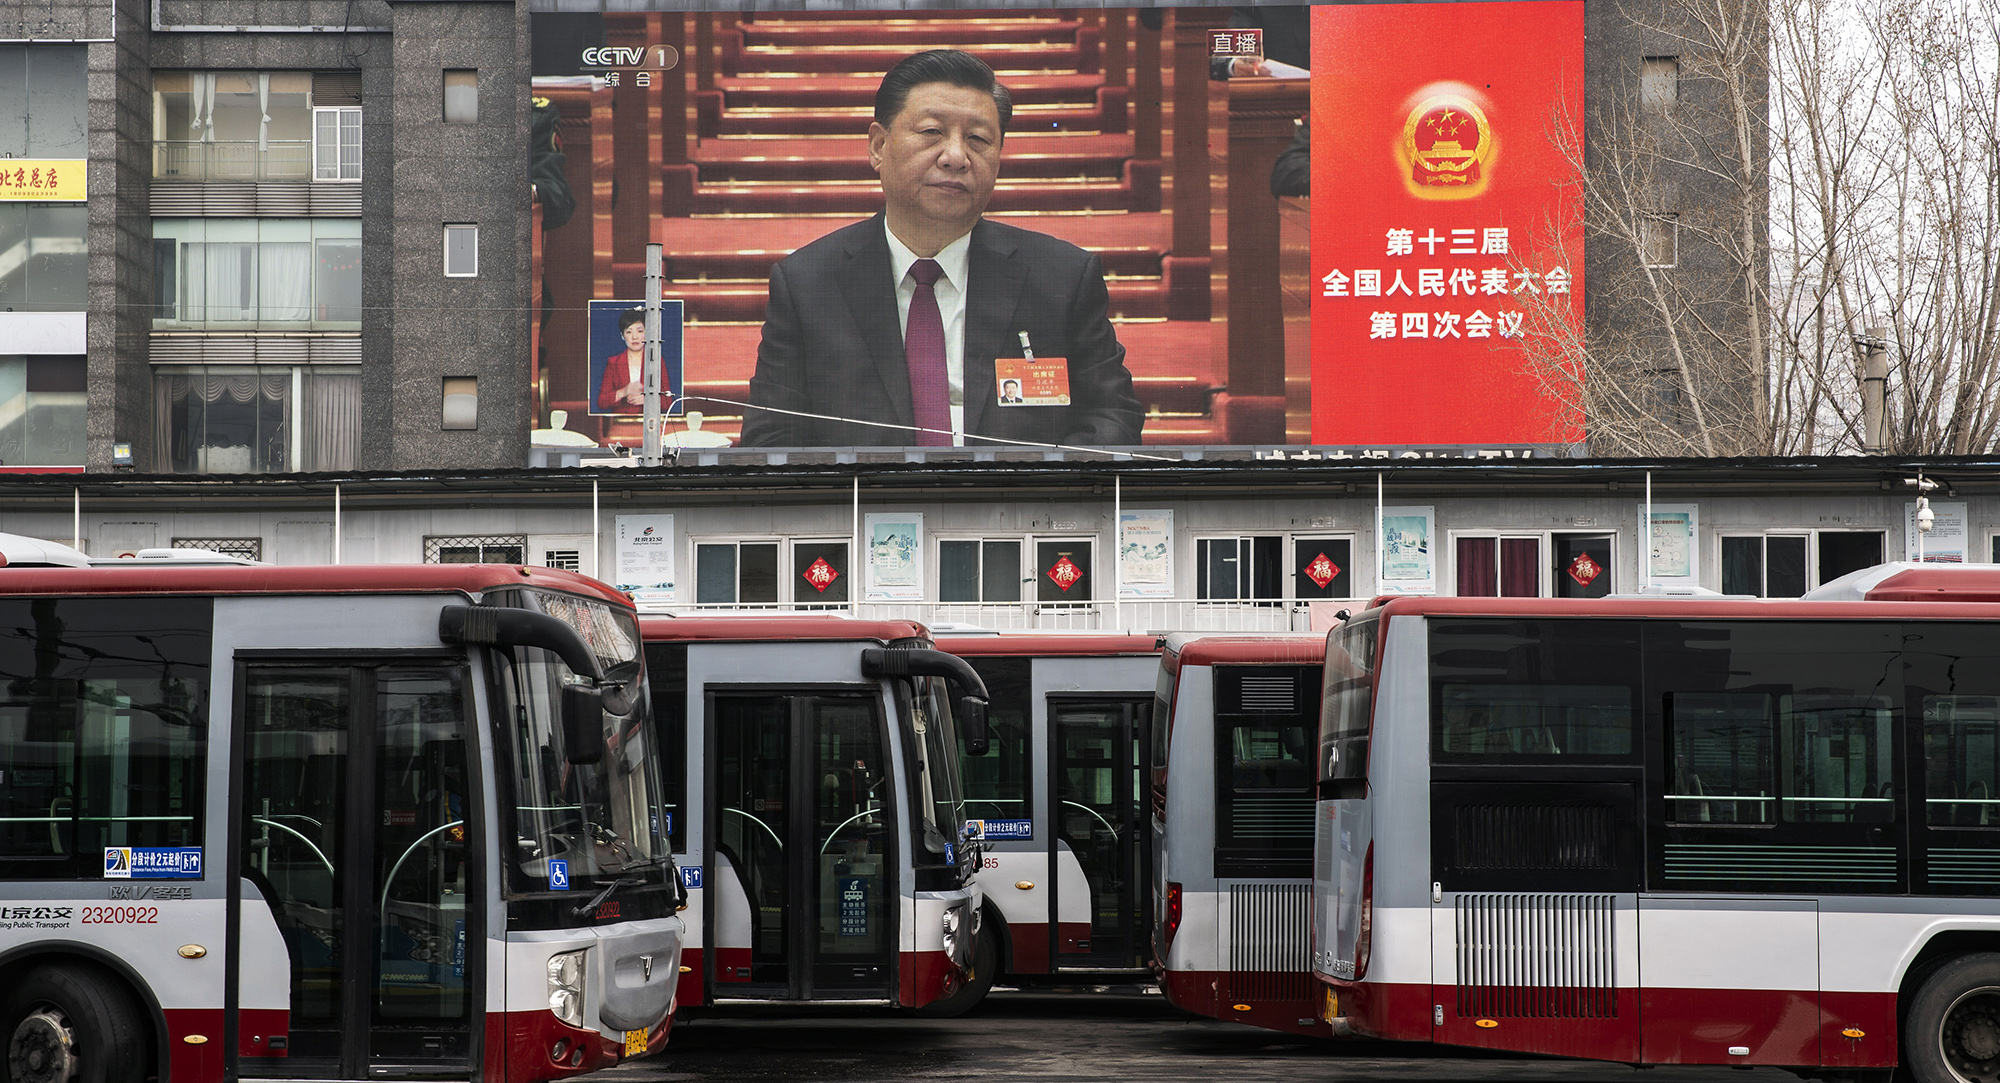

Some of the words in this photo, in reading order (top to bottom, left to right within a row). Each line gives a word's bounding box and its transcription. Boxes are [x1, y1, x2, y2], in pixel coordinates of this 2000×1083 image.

[1213, 33, 1256, 53] 直播
[582, 47, 644, 65] CCTV
[657, 49, 664, 66] 1
[605, 72, 650, 87] 综合
[0, 167, 58, 189] 北京总店
[1385, 228, 1509, 255] 第十三届
[1321, 266, 1572, 297] 全国人民代表大会
[1369, 310, 1525, 339] 第四次会议
[812, 564, 829, 583] 福
[1056, 564, 1074, 582] 福
[1314, 561, 1332, 579] 福
[1576, 560, 1593, 578] 福
[132, 852, 180, 866] 分段计价2元起价
[81, 906, 158, 924] 2320922
[13, 921, 34, 929] Public
[36, 921, 70, 930] Transport
